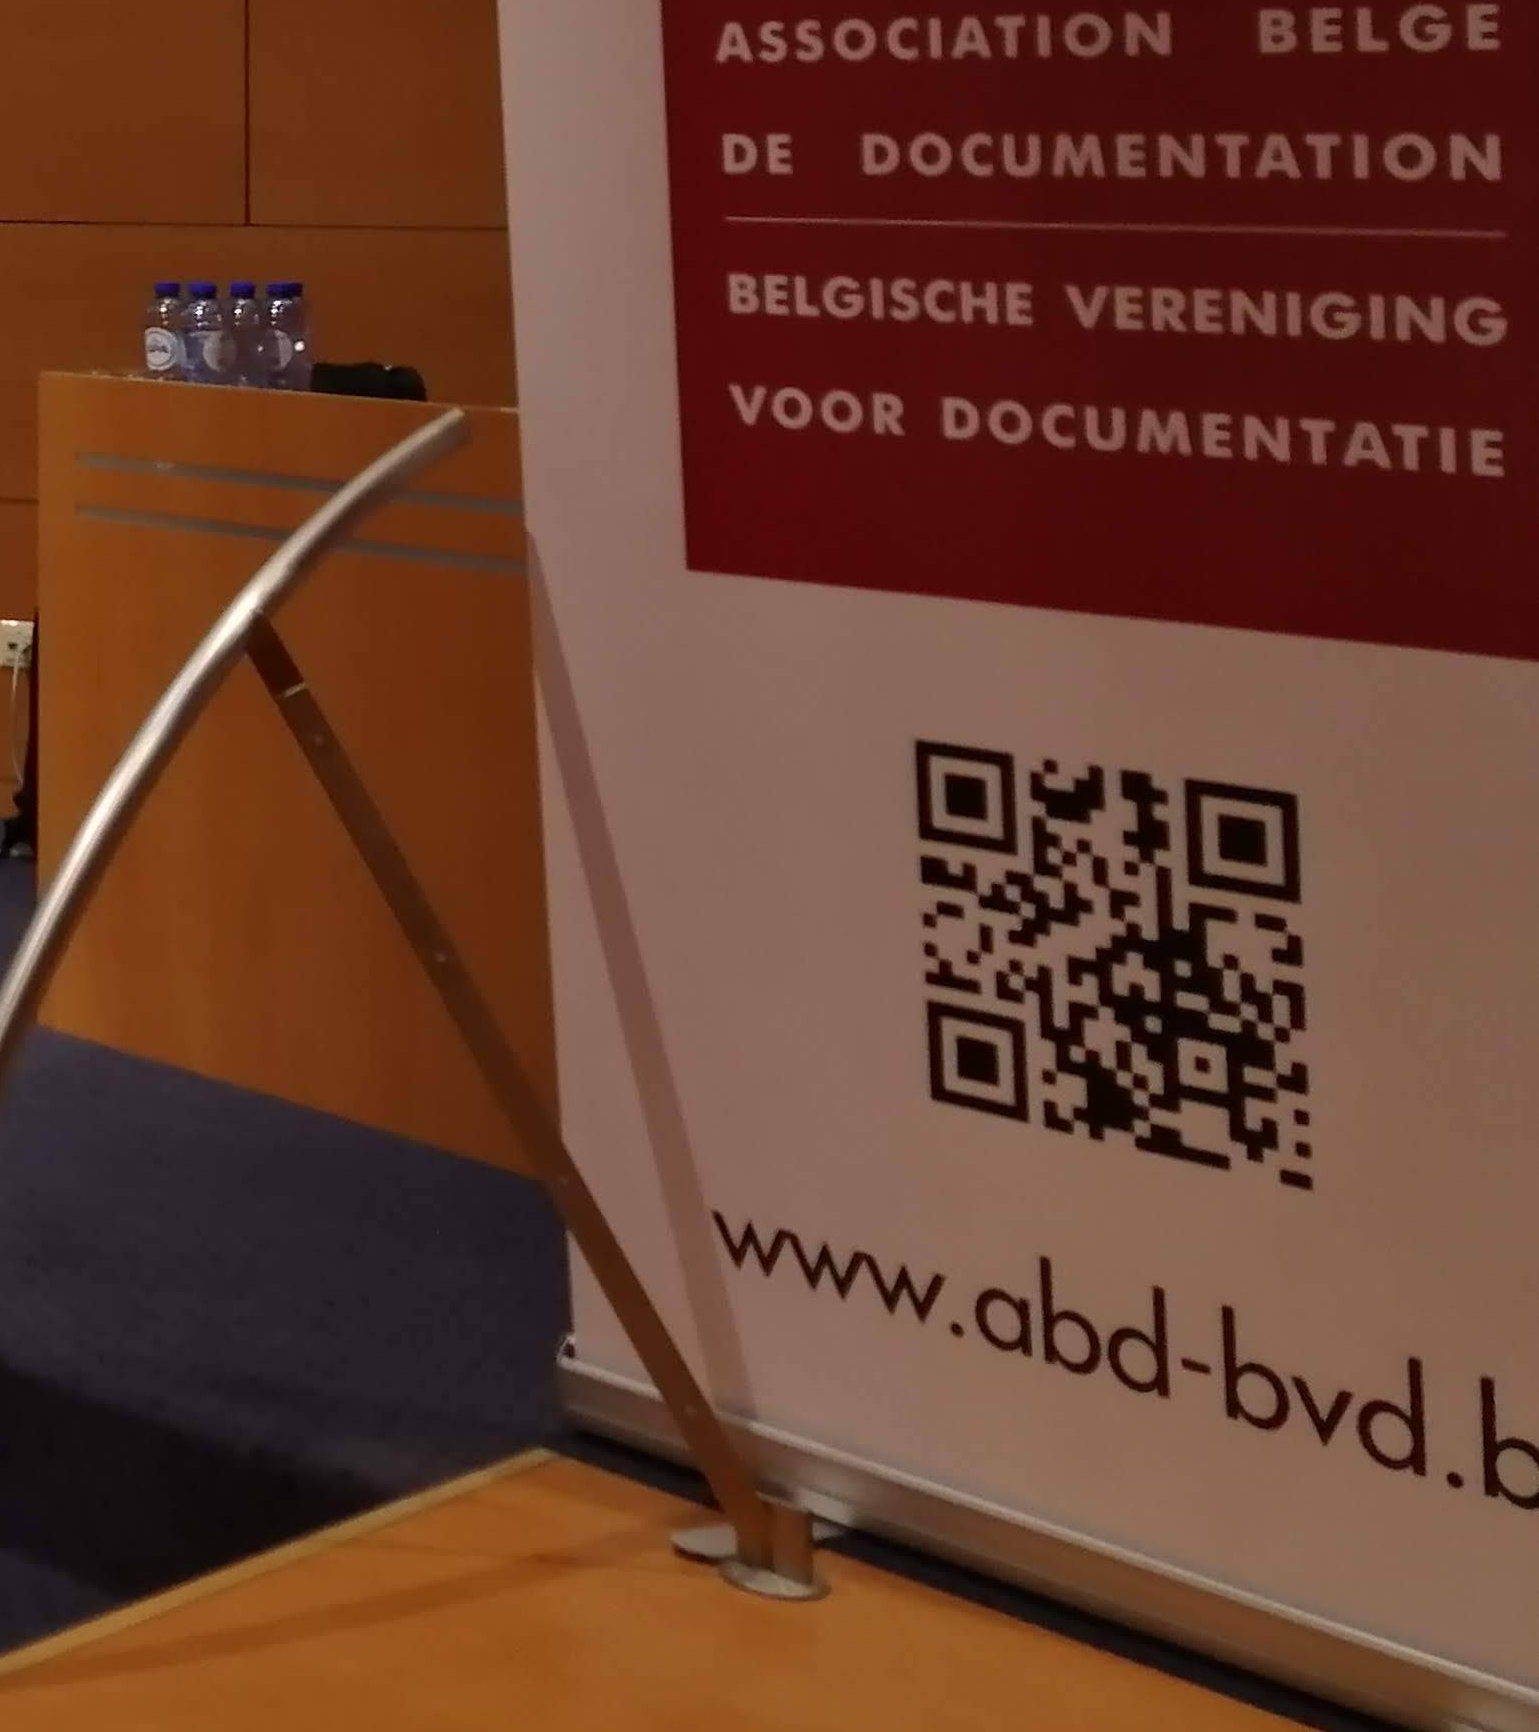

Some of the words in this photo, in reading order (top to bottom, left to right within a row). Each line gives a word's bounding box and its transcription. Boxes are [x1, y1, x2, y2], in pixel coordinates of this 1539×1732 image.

[716, 11, 1174, 64] ASSOCIATION
[1258, 3, 1503, 55] BELGE
[722, 132, 795, 176] DE
[861, 132, 1503, 182] DOCUMENTATION
[727, 271, 1035, 328] BELGISCHE
[1065, 284, 1509, 347] VERENIGING
[729, 382, 906, 436] VOOR
[941, 396, 1506, 478] DOCUMENTATIE
[713, 1209, 1539, 1510] www.abd-bvd.b
